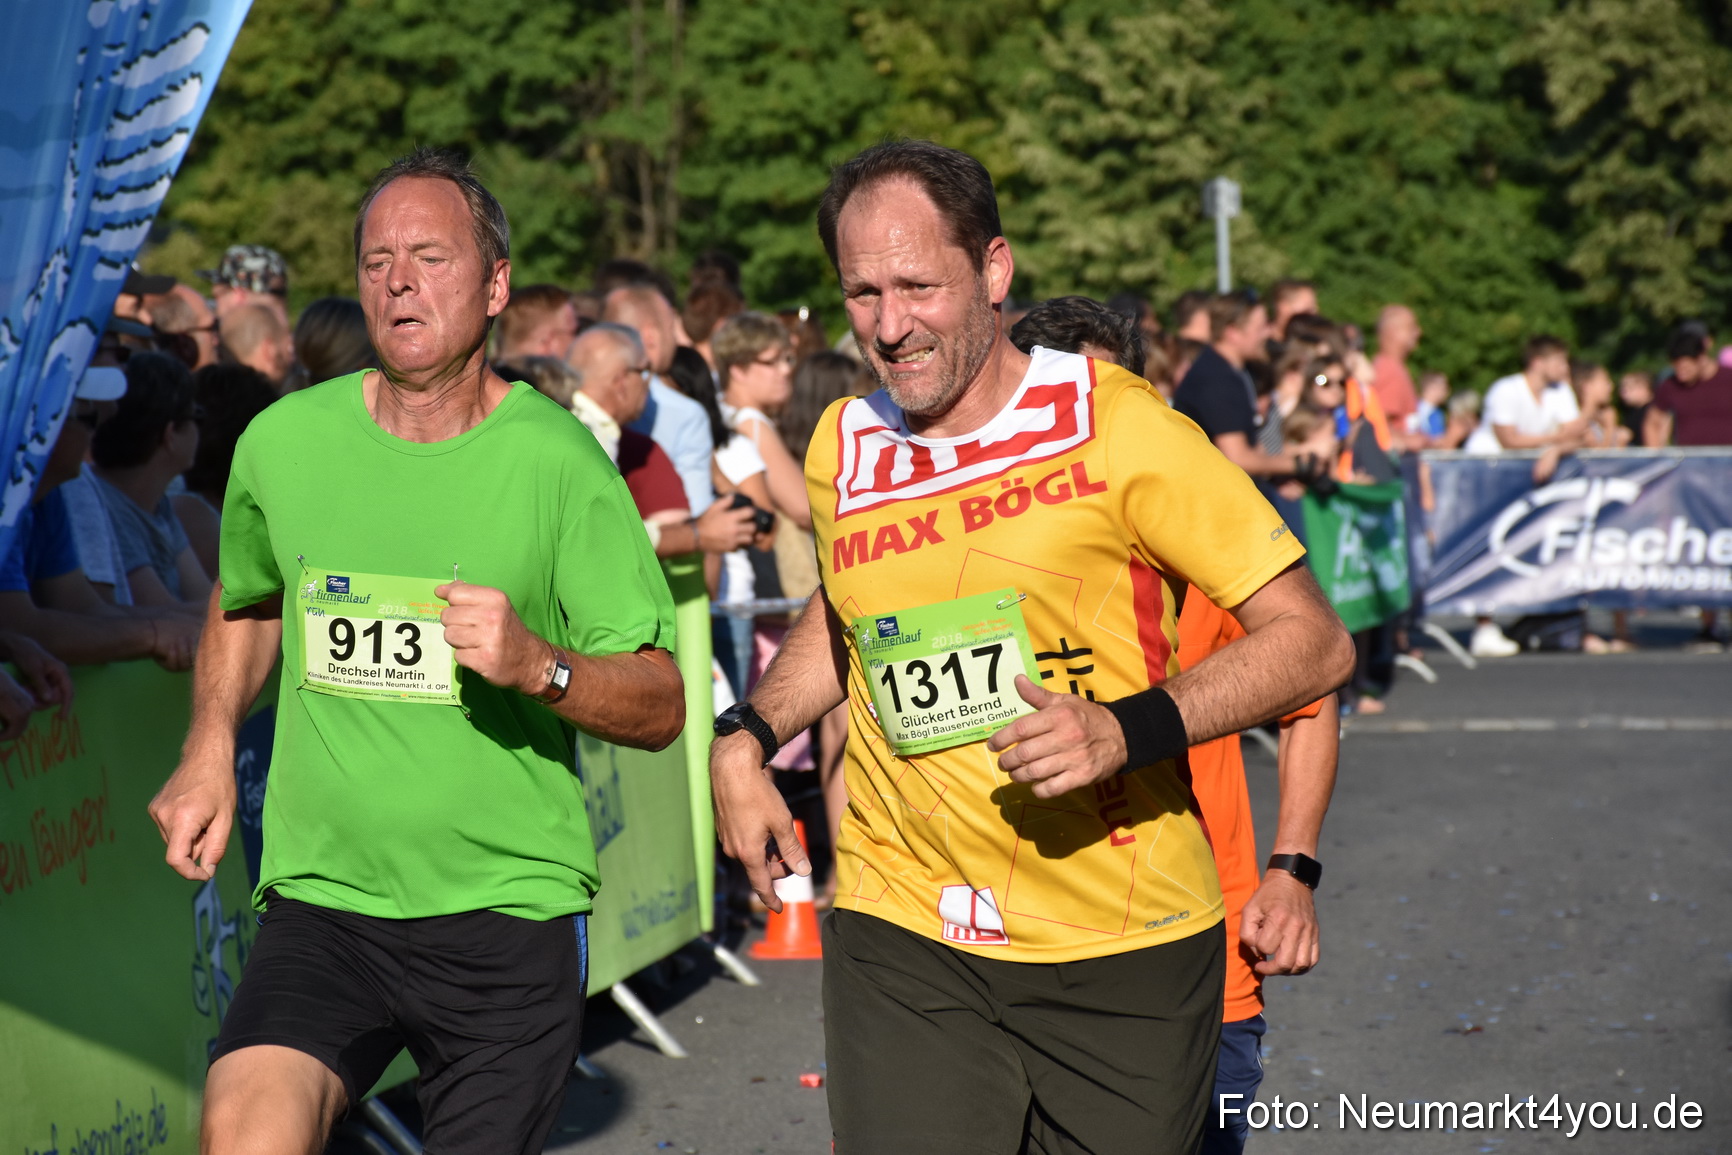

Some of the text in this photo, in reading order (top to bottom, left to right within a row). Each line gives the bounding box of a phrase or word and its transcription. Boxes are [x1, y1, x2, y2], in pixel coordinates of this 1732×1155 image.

[833, 460, 1109, 575] MAX BÖGL
[1538, 515, 1732, 565] Fische
[1563, 566, 1732, 591] AUTOMOBIL
[315, 588, 372, 605] firmenlauf
[377, 603, 409, 616] 2018
[328, 617, 422, 666] 913
[871, 628, 922, 649] firmenlauf
[931, 632, 963, 650] 2018
[307, 672, 330, 682] Kliniken
[343, 677, 383, 687] Landkreises
[385, 681, 419, 689] Neumarkt
[427, 682, 434, 690] d.
[328, 662, 425, 681] Drechsel Martin
[880, 643, 1003, 714] 1317
[896, 731, 910, 742] Max
[910, 726, 931, 741] Bögl
[932, 716, 986, 736] Bauservice
[987, 706, 1018, 723] GmbH
[901, 697, 1003, 729] Glückert Bernd
[31, 764, 116, 887] länger!
